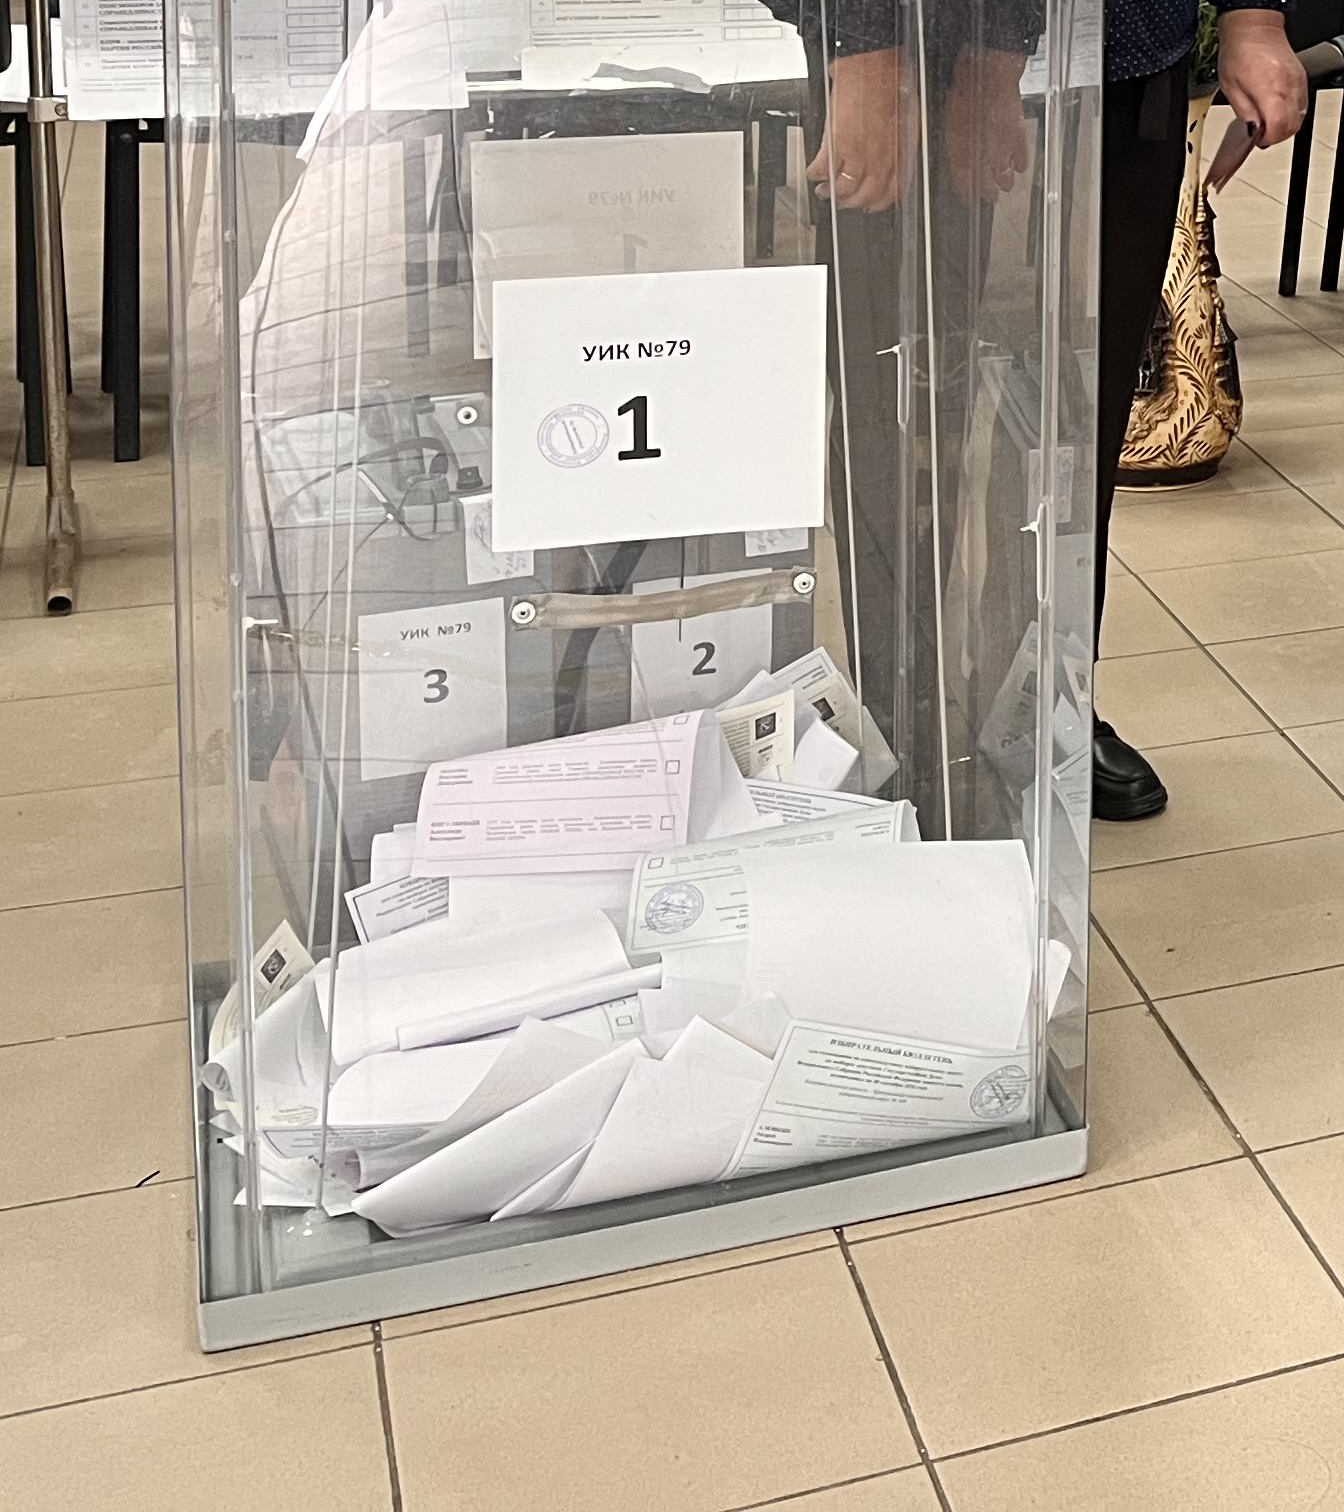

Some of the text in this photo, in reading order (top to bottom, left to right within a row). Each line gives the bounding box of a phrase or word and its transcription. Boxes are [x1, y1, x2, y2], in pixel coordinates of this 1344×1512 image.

[582, 339, 691, 362] УИК №79
[617, 395, 662, 461] 1
[400, 622, 472, 641] УИК №79
[691, 641, 717, 676] 2
[423, 668, 450, 704] 3
